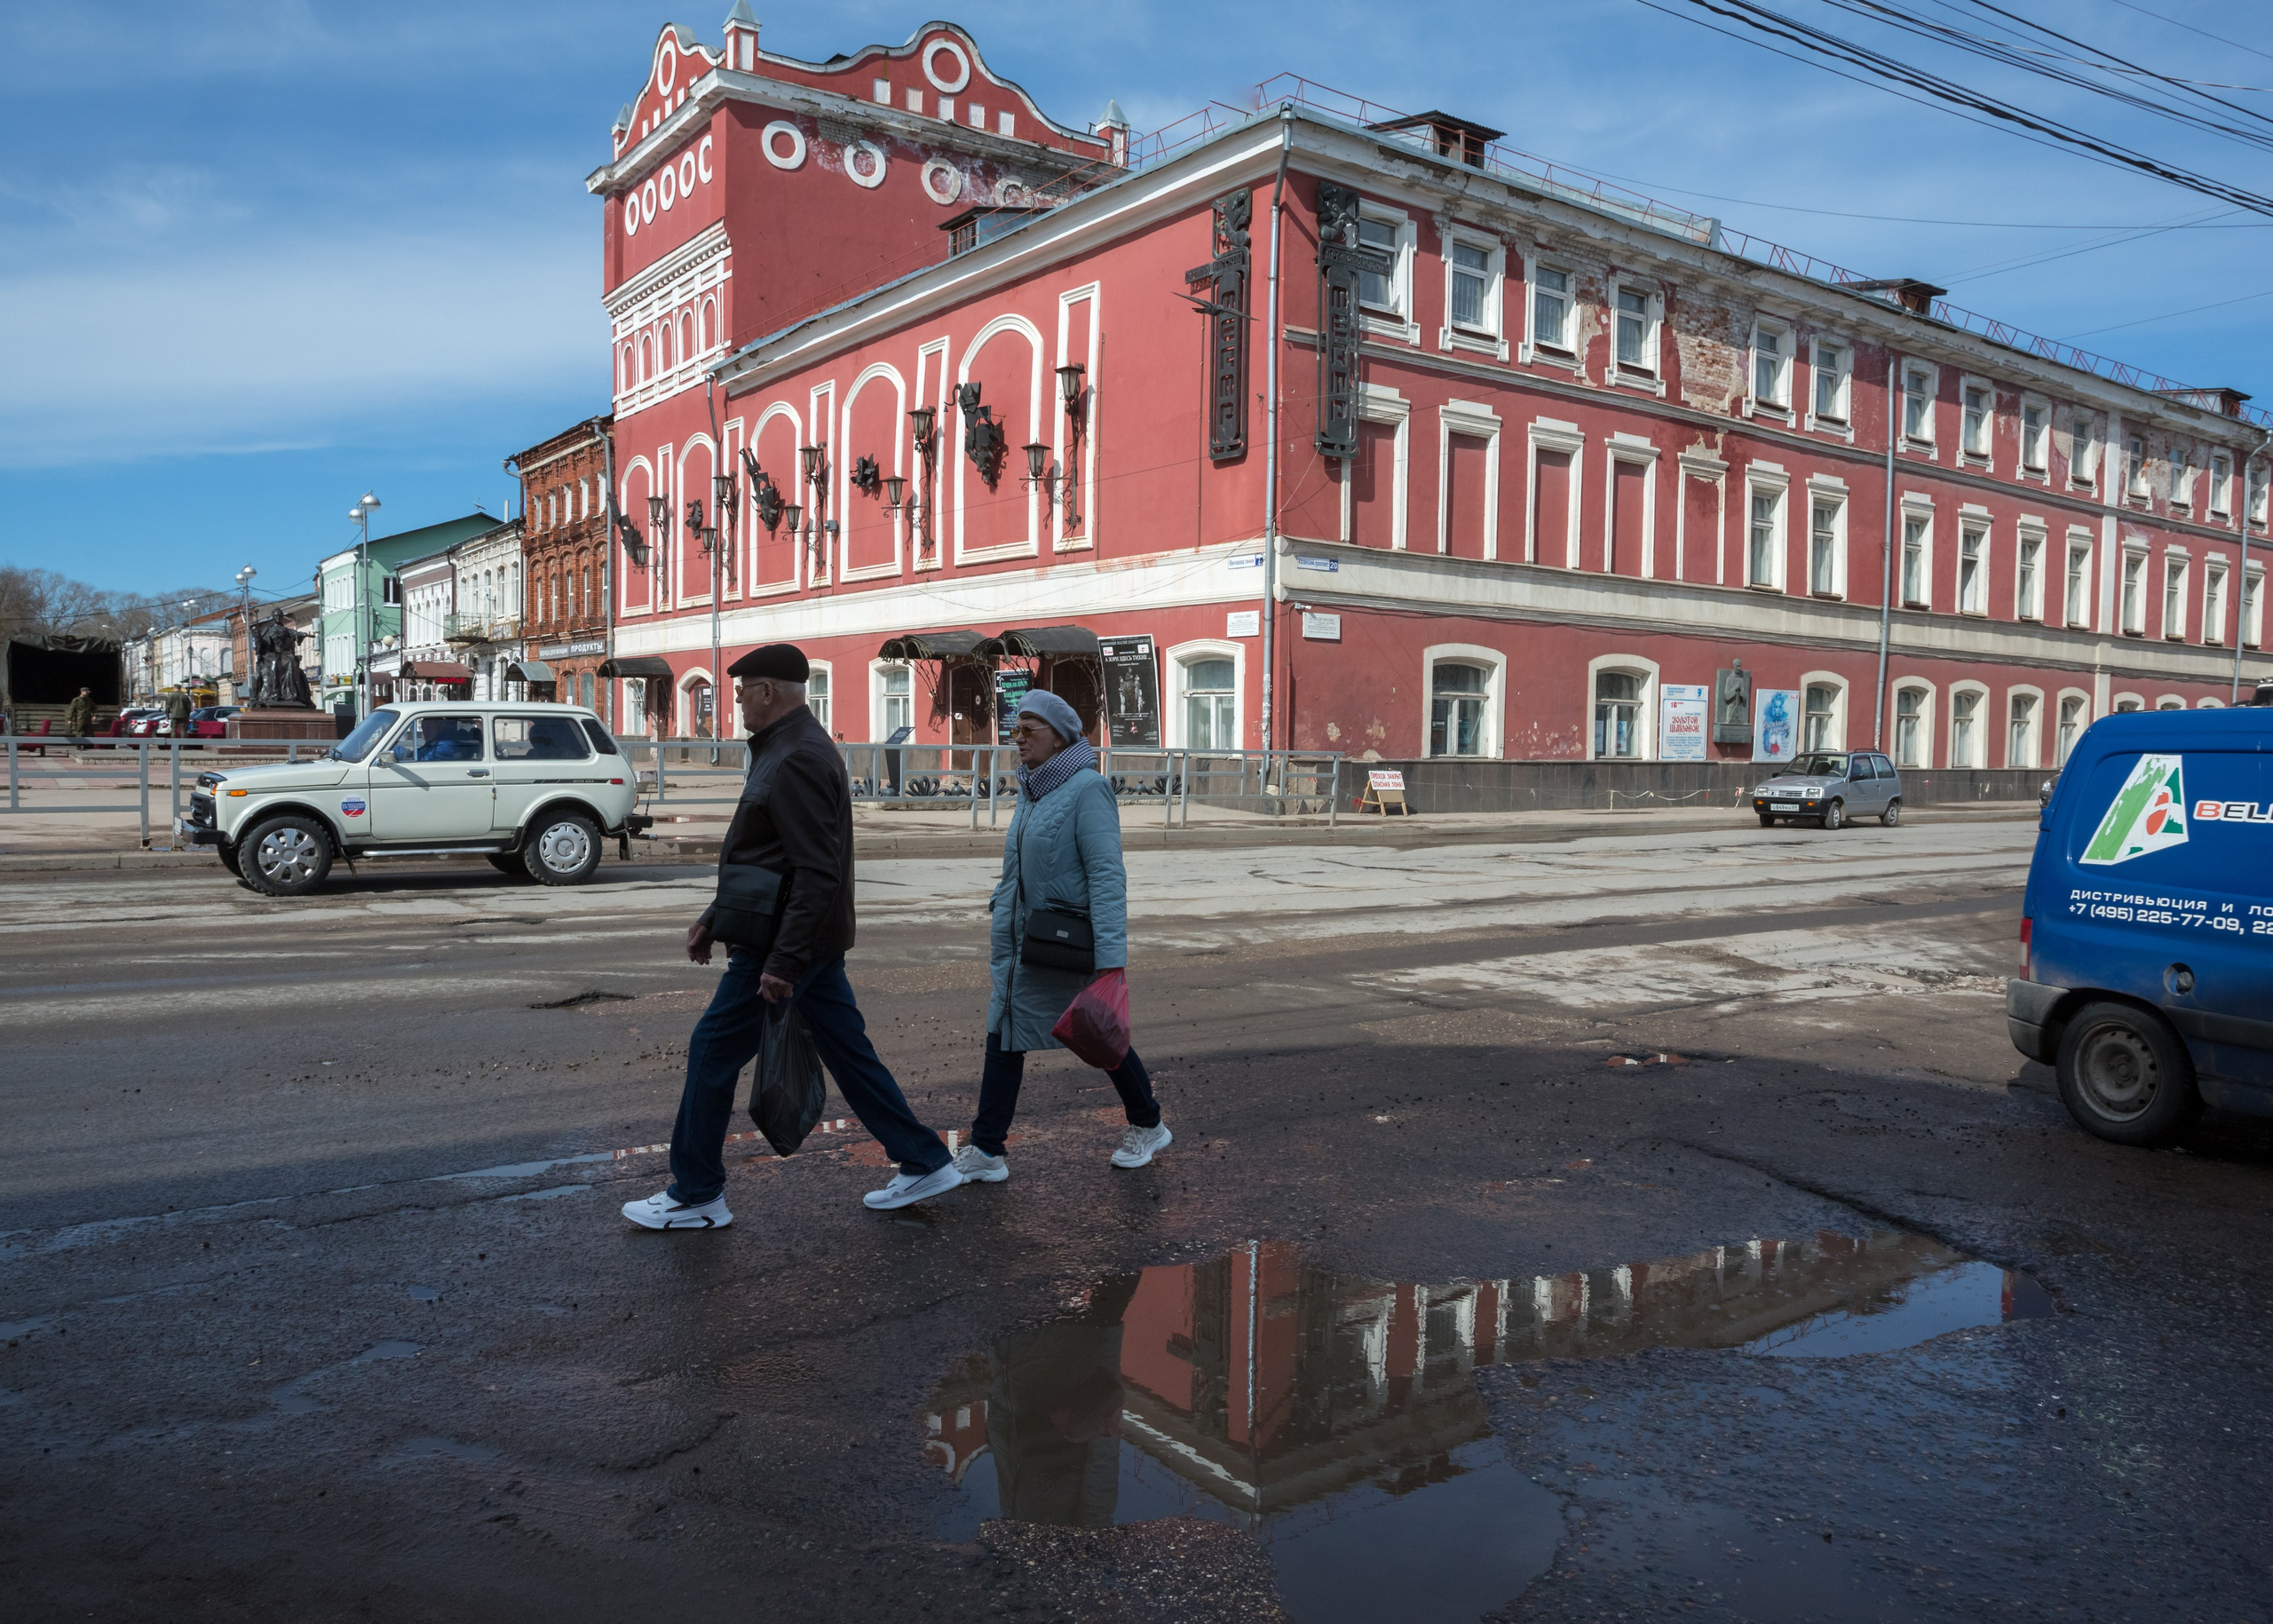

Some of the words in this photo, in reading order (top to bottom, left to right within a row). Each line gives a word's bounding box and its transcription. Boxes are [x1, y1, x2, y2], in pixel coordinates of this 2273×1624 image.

[571, 642, 603, 653] ПРОДУКТЫ
[1671, 716, 1699, 725] ЗОЛОТОЙ
[2193, 800, 2273, 824] BEL
[2070, 889, 2208, 911] ДИСТРИБЬЮЦИЯ
[2222, 903, 2234, 914] И
[2069, 903, 2087, 915] +7
[2090, 904, 2134, 922] (495)
[2136, 909, 2245, 935] 225-77-09,
